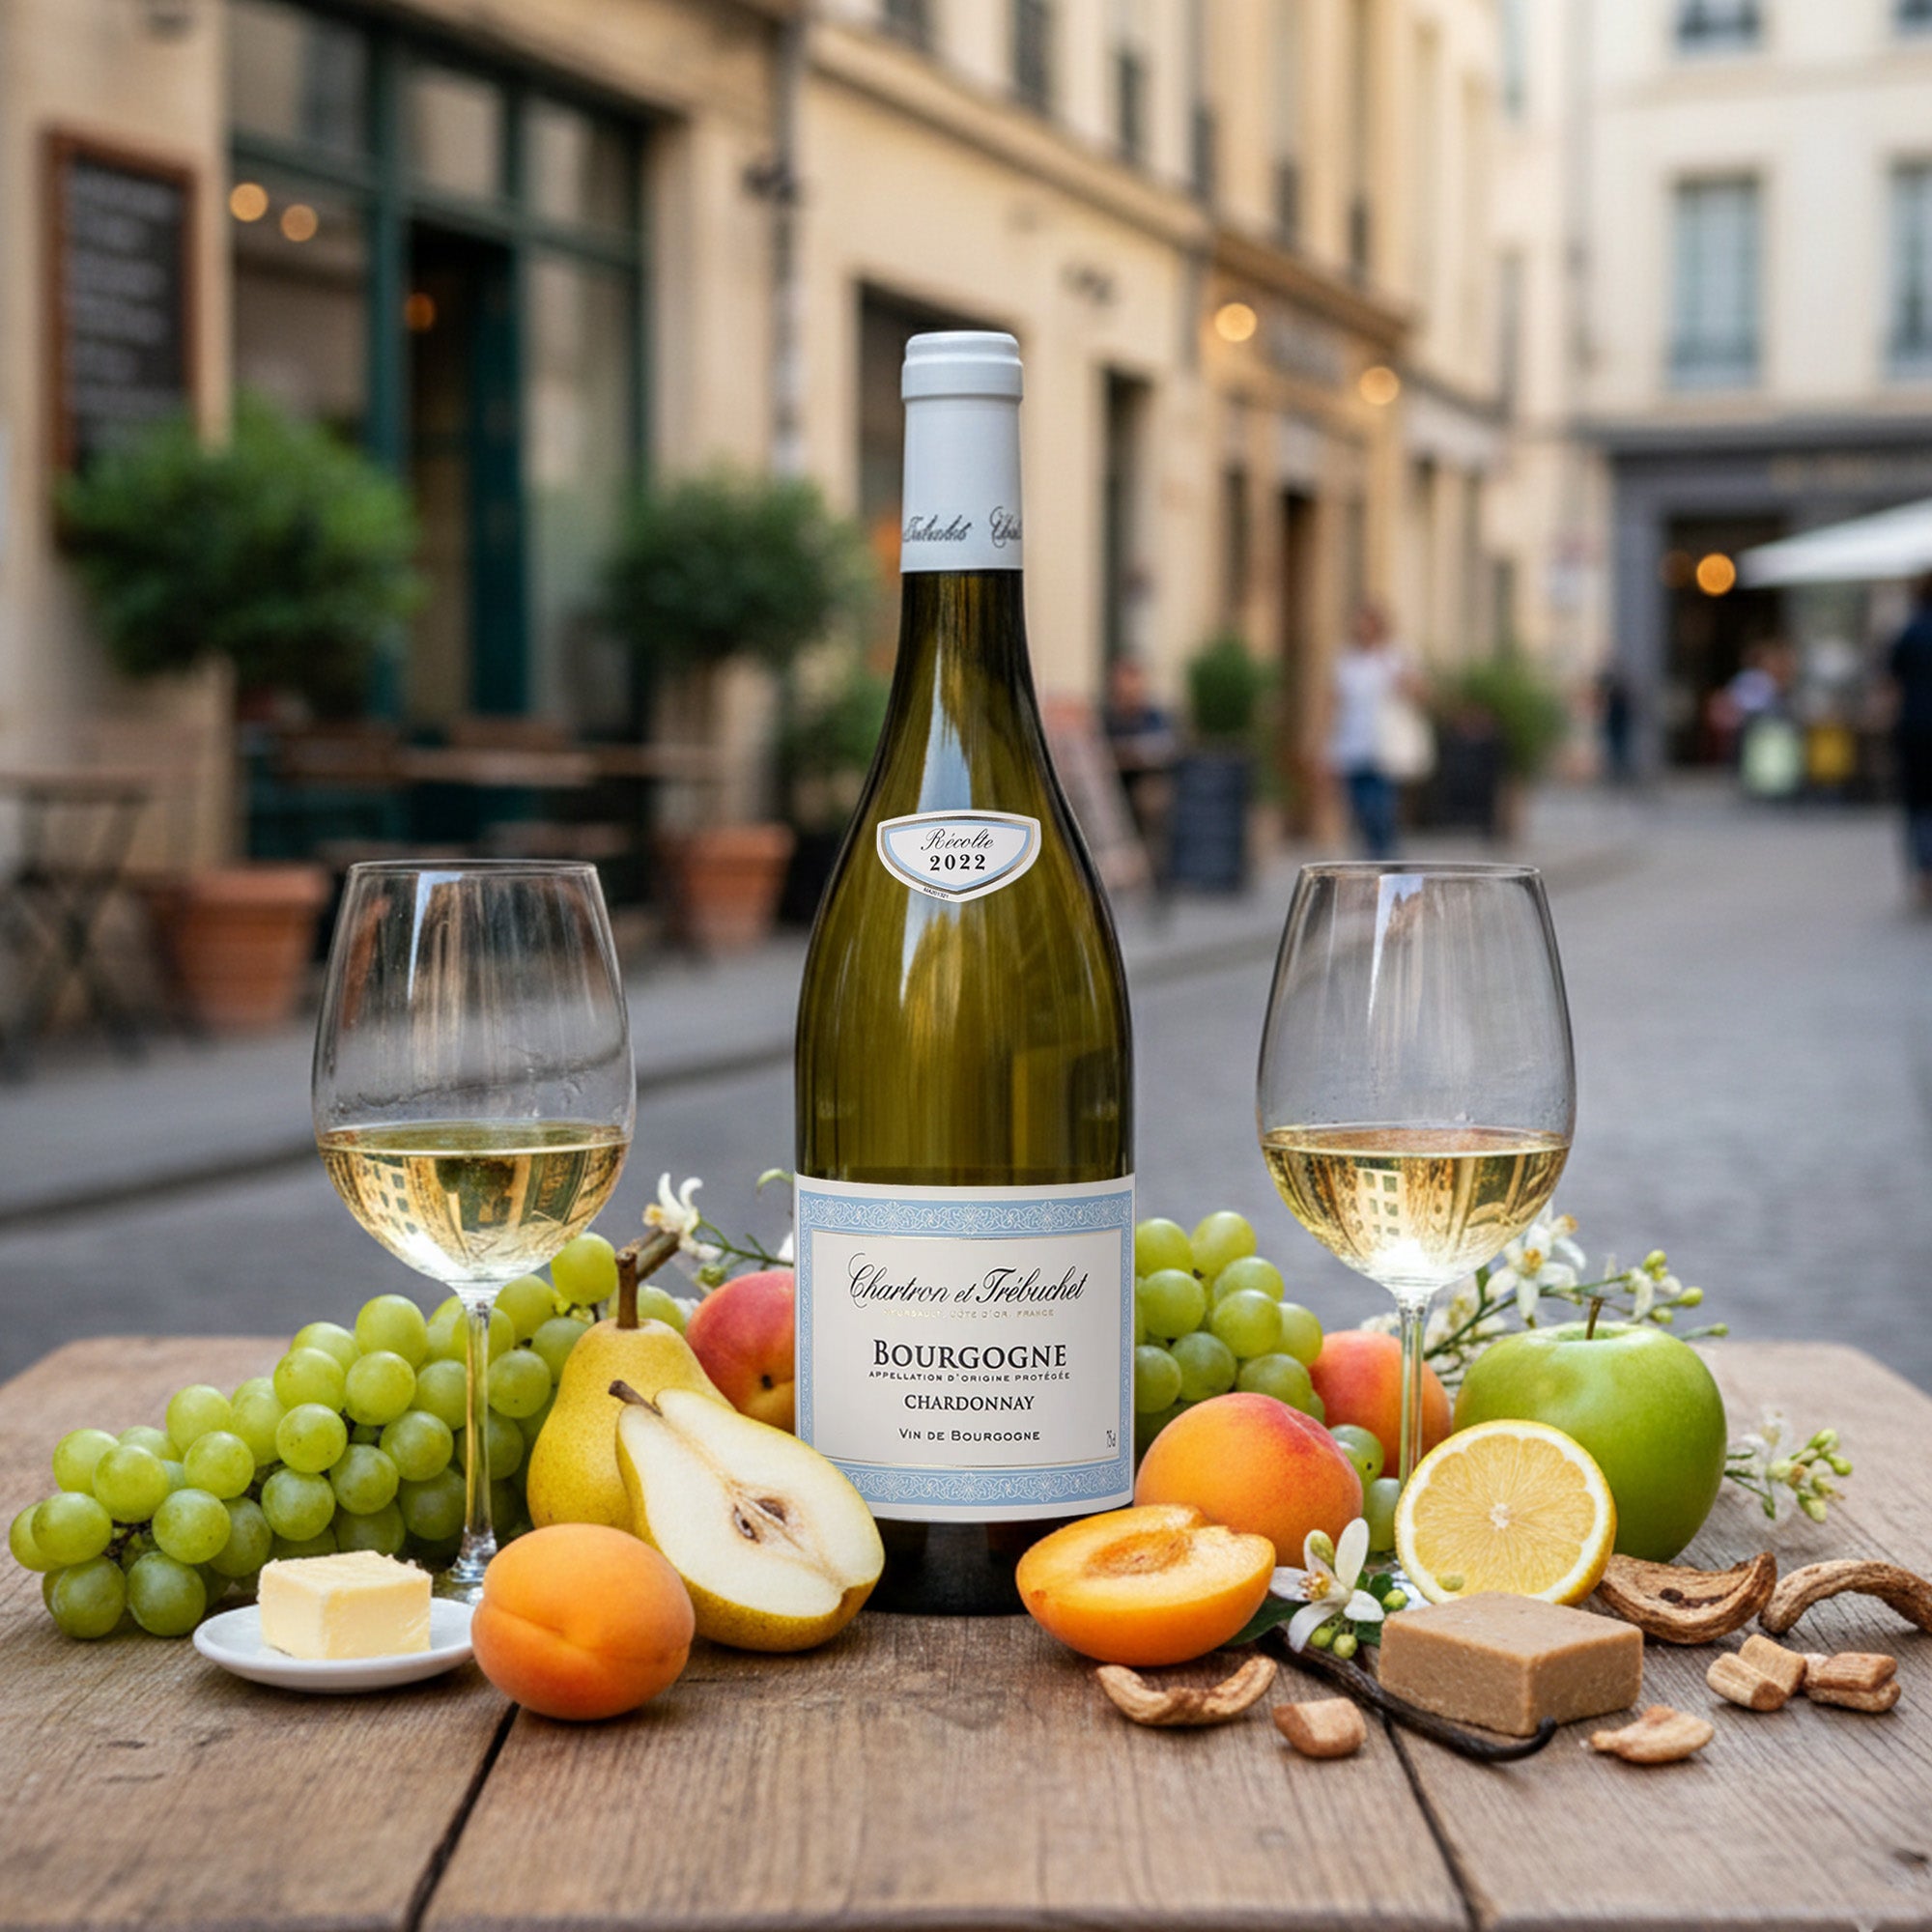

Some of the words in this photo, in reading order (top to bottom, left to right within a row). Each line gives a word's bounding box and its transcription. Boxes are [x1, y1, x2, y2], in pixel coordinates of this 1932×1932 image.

[921, 828, 994, 851] Récolte
[929, 854, 985, 871] 2022
[848, 1252, 950, 1308] Chartron
[953, 1283, 977, 1303] et
[976, 1265, 1089, 1304] Trébuchet
[1016, 1308, 1054, 1318] FRANCE
[873, 1339, 1066, 1369] BOURGOGNE
[869, 1371, 942, 1381] APPELLATION
[948, 1374, 1009, 1382] D'ORIGINE
[1015, 1370, 1069, 1381] PROTÉGÉE
[904, 1394, 1035, 1410] CHARDONNAY
[898, 1428, 921, 1439] VIN
[927, 1431, 945, 1440] DE
[951, 1430, 1040, 1441] BOURGOGNE
